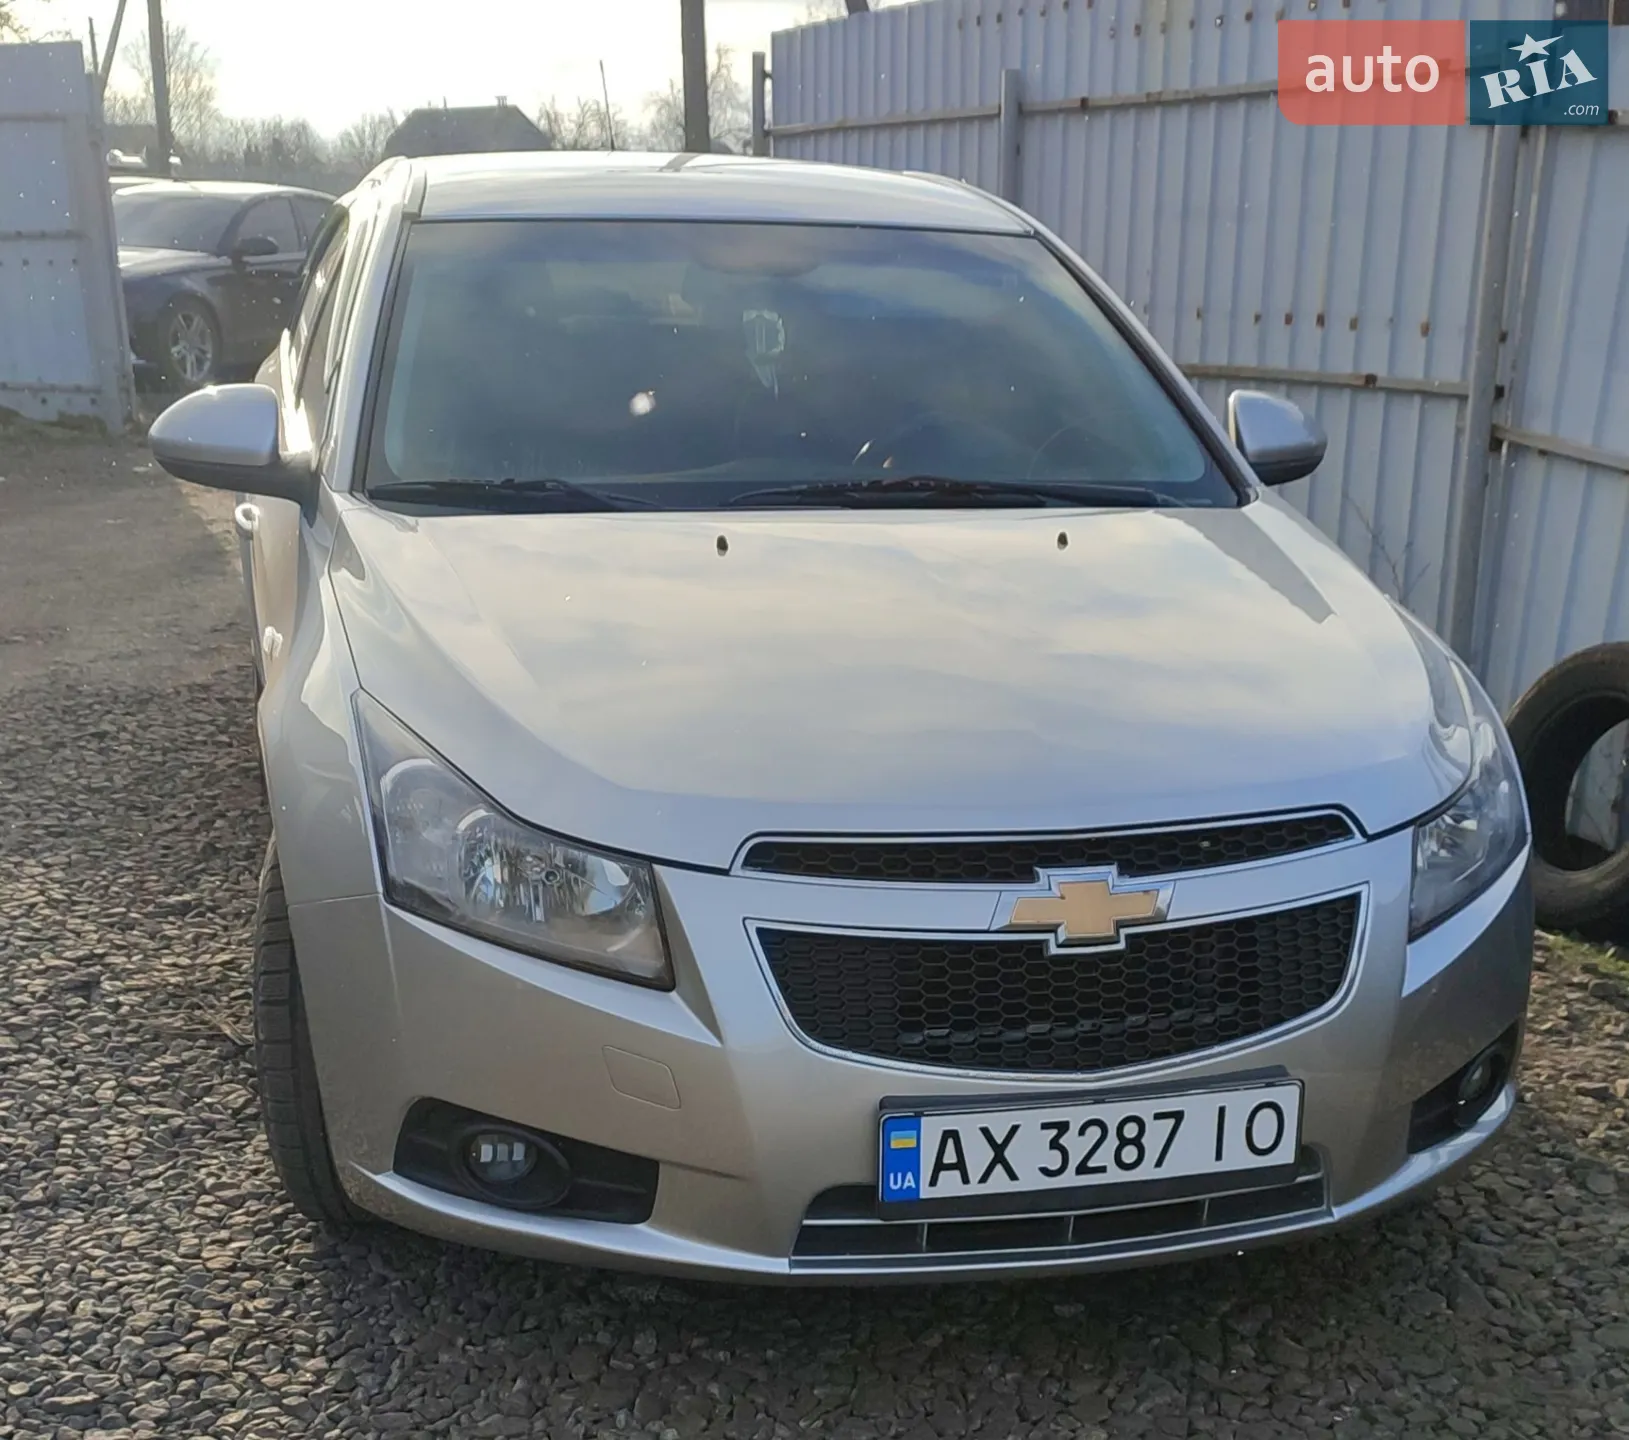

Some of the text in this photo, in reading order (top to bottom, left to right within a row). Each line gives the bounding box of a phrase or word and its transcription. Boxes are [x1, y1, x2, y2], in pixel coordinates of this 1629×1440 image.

[928, 1100, 1285, 1187] AX 3287 IO
[889, 1172, 916, 1190] UA
